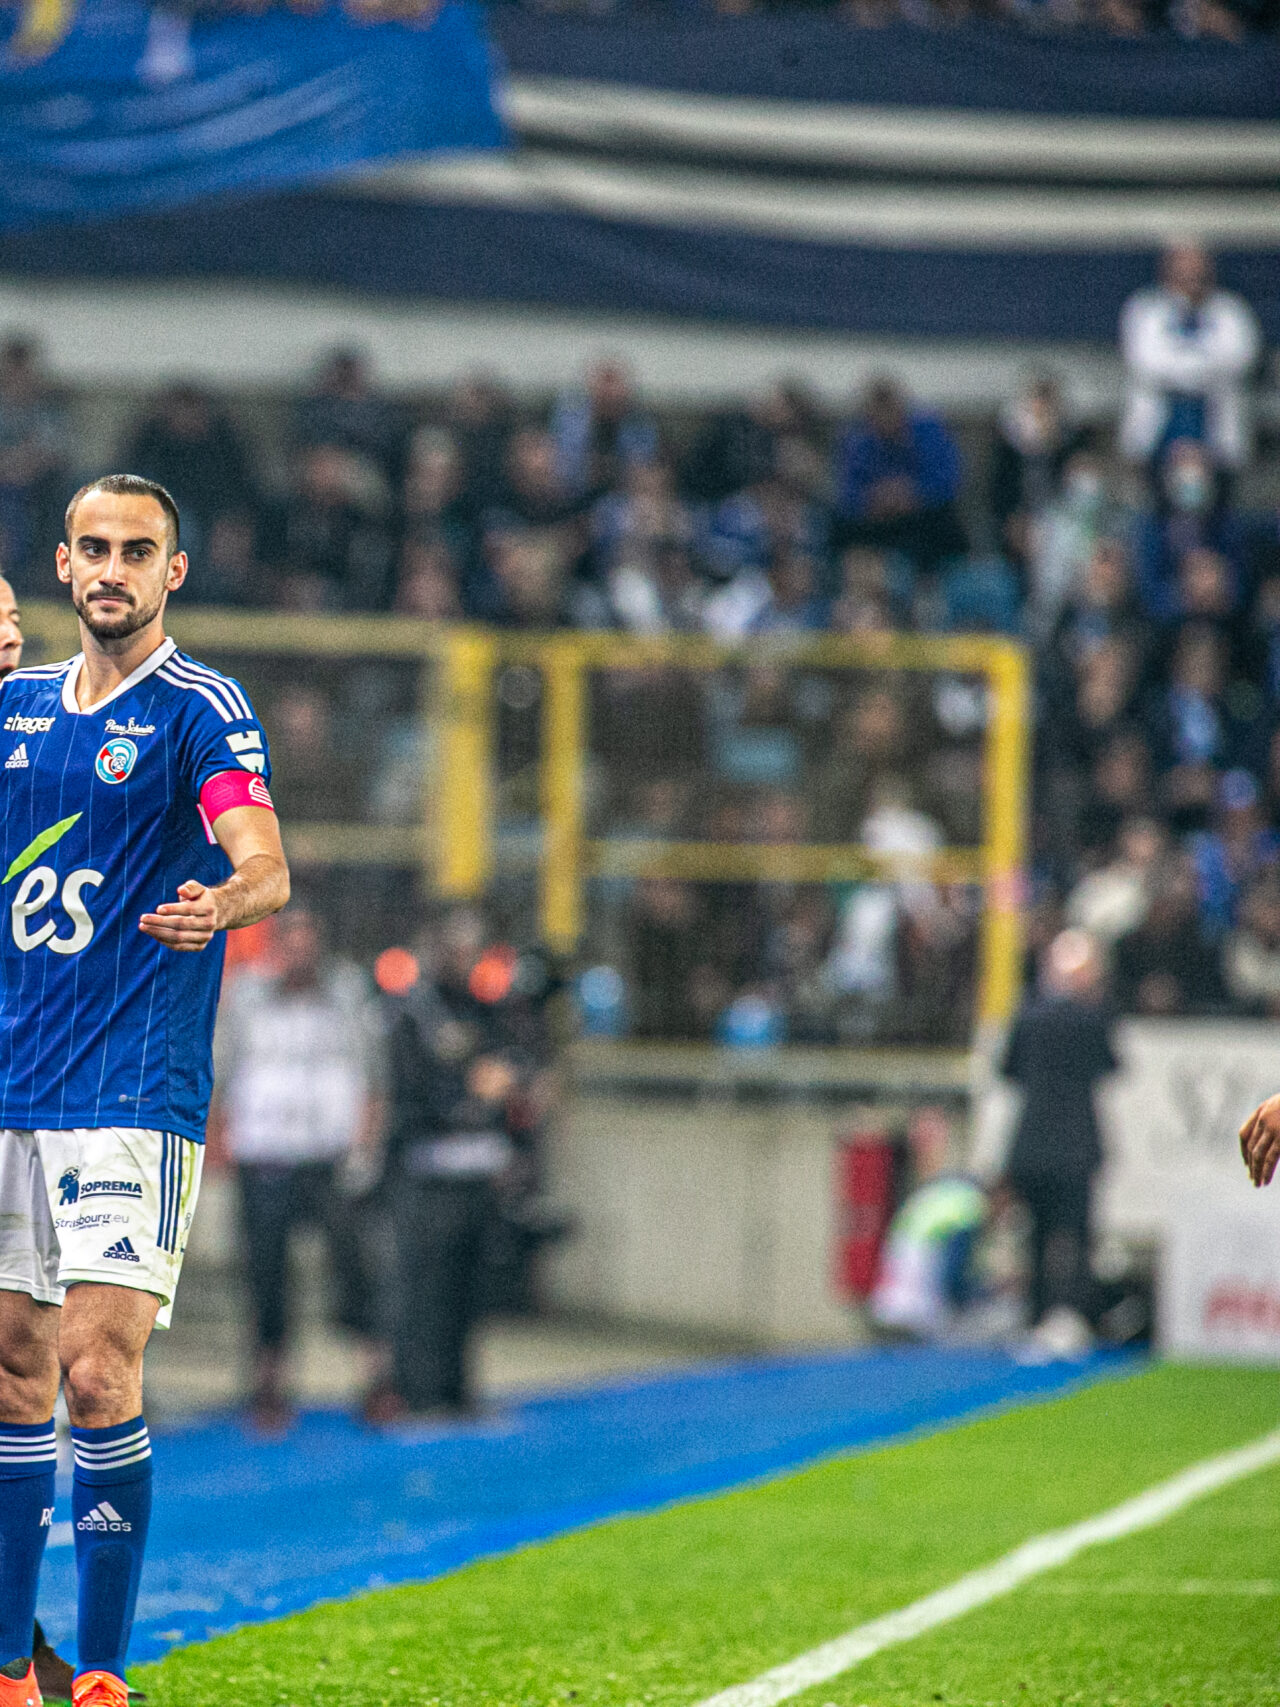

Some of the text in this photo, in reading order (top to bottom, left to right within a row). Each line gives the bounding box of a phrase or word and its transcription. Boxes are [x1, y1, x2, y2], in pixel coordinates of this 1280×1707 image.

[5, 759, 29, 768] adidas
[80, 1181, 143, 1194] SOPREMA
[102, 1251, 141, 1262] adidas
[76, 1519, 132, 1532] adidas
